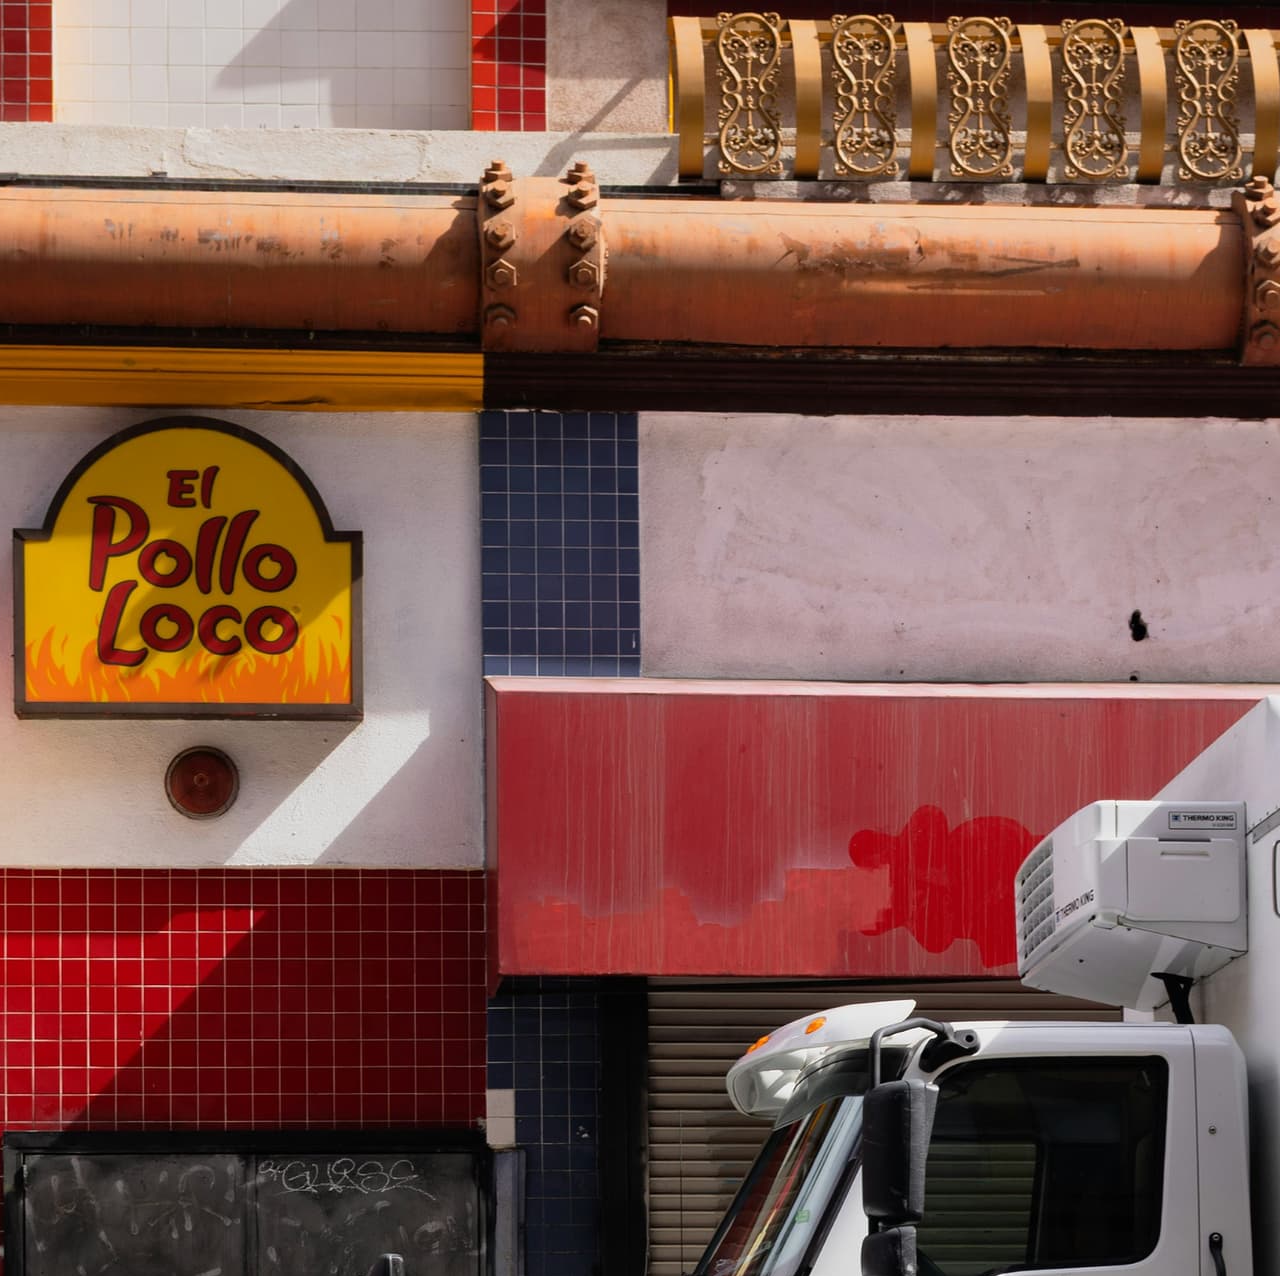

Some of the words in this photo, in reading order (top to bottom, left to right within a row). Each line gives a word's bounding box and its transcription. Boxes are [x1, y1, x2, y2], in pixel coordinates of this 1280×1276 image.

[166, 465, 220, 509] El
[86, 494, 298, 595] Pollo
[96, 579, 300, 667] Loco
[1182, 814, 1215, 822] THERMO
[1216, 814, 1235, 822] KING
